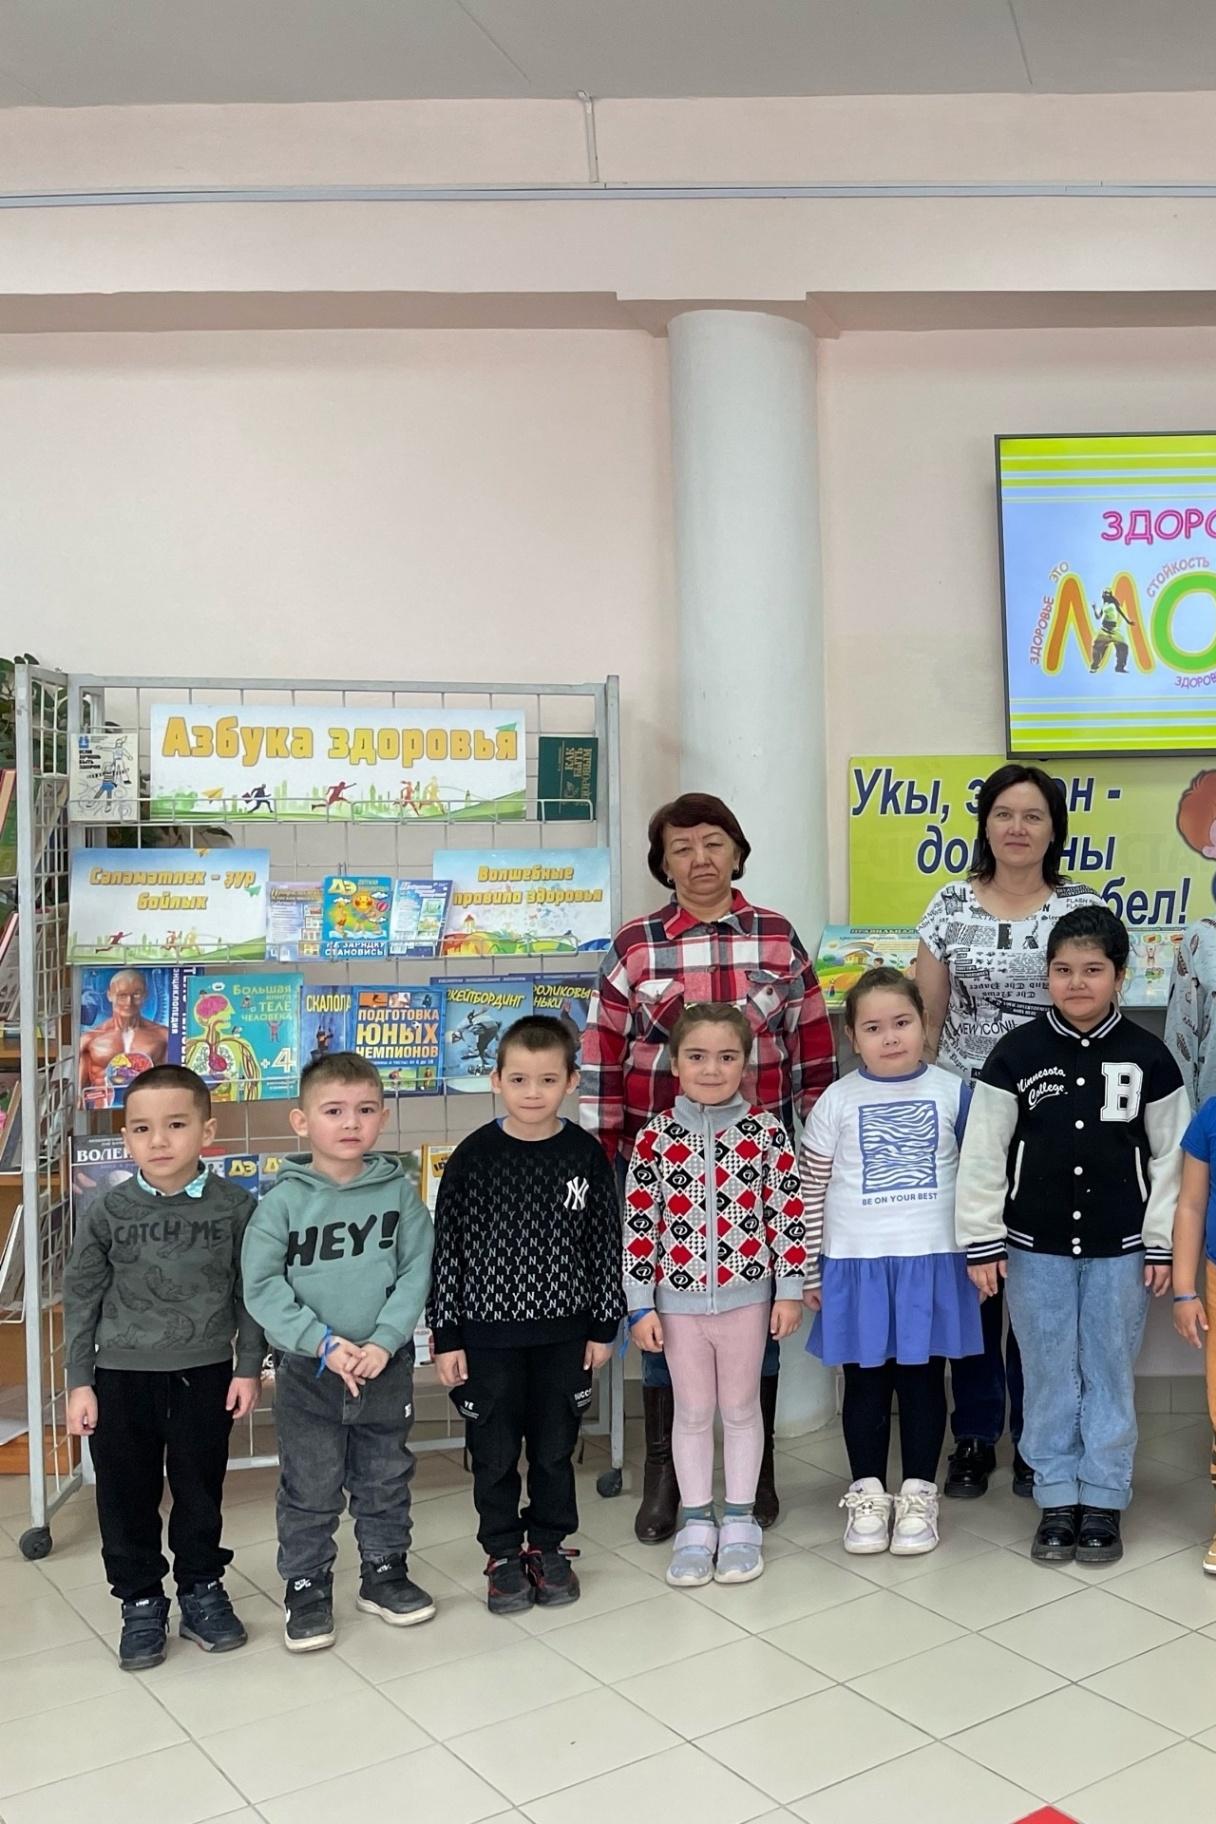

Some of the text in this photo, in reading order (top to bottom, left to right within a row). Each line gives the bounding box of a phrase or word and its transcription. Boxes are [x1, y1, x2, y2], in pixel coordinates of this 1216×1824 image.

[1146, 556, 1210, 598] СТОЙКОСТЬ
[1030, 561, 1069, 665] ЗДОРОВЬЕ ЭТО
[161, 716, 314, 767] Азбука
[328, 728, 518, 768] здоровья
[564, 747, 575, 771] КАК
[477, 865, 574, 882] Волшебные
[328, 878, 358, 895] ДЭ
[453, 887, 603, 909] правила здоровья
[1100, 877, 1191, 926] бел!
[171, 967, 180, 1035] ЭНЦИКЛОПЕДИЯ
[259, 1001, 292, 1012] ТЕЛЕ
[358, 1009, 440, 1023] ПОДГОТОВКА
[356, 1023, 439, 1045] ЮНЫХ
[356, 1046, 439, 1059] ЧЕМПИОНОВ
[1100, 1062, 1143, 1123] B
[229, 1160, 257, 1177] ДЭ
[862, 1192, 938, 1206] BE ON YOUR BEST
[114, 1219, 223, 1247] CATCH ME
[287, 1210, 400, 1267] HEY!
